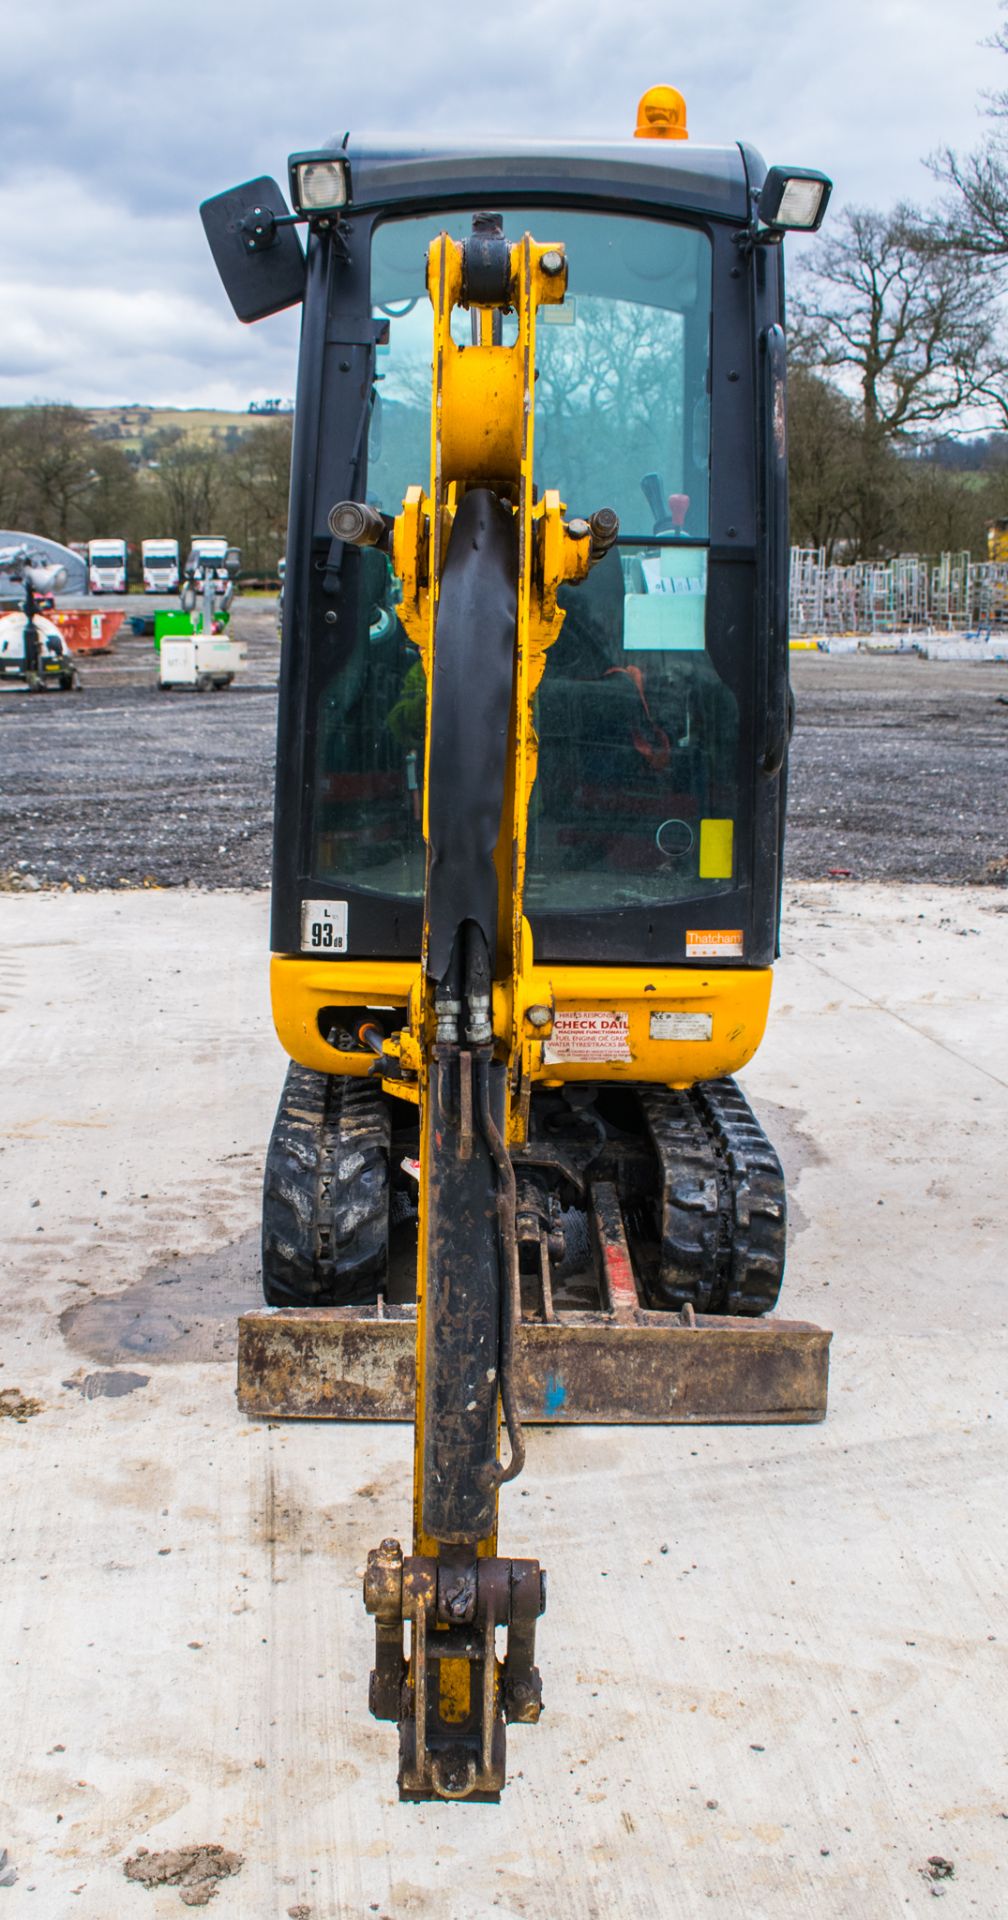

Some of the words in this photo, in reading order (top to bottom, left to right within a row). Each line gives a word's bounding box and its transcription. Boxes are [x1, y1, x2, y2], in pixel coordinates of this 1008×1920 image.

[688, 933, 741, 944] Thatcham
[554, 1020, 597, 1030] CHECK
[600, 1020, 630, 1030] DAIL
